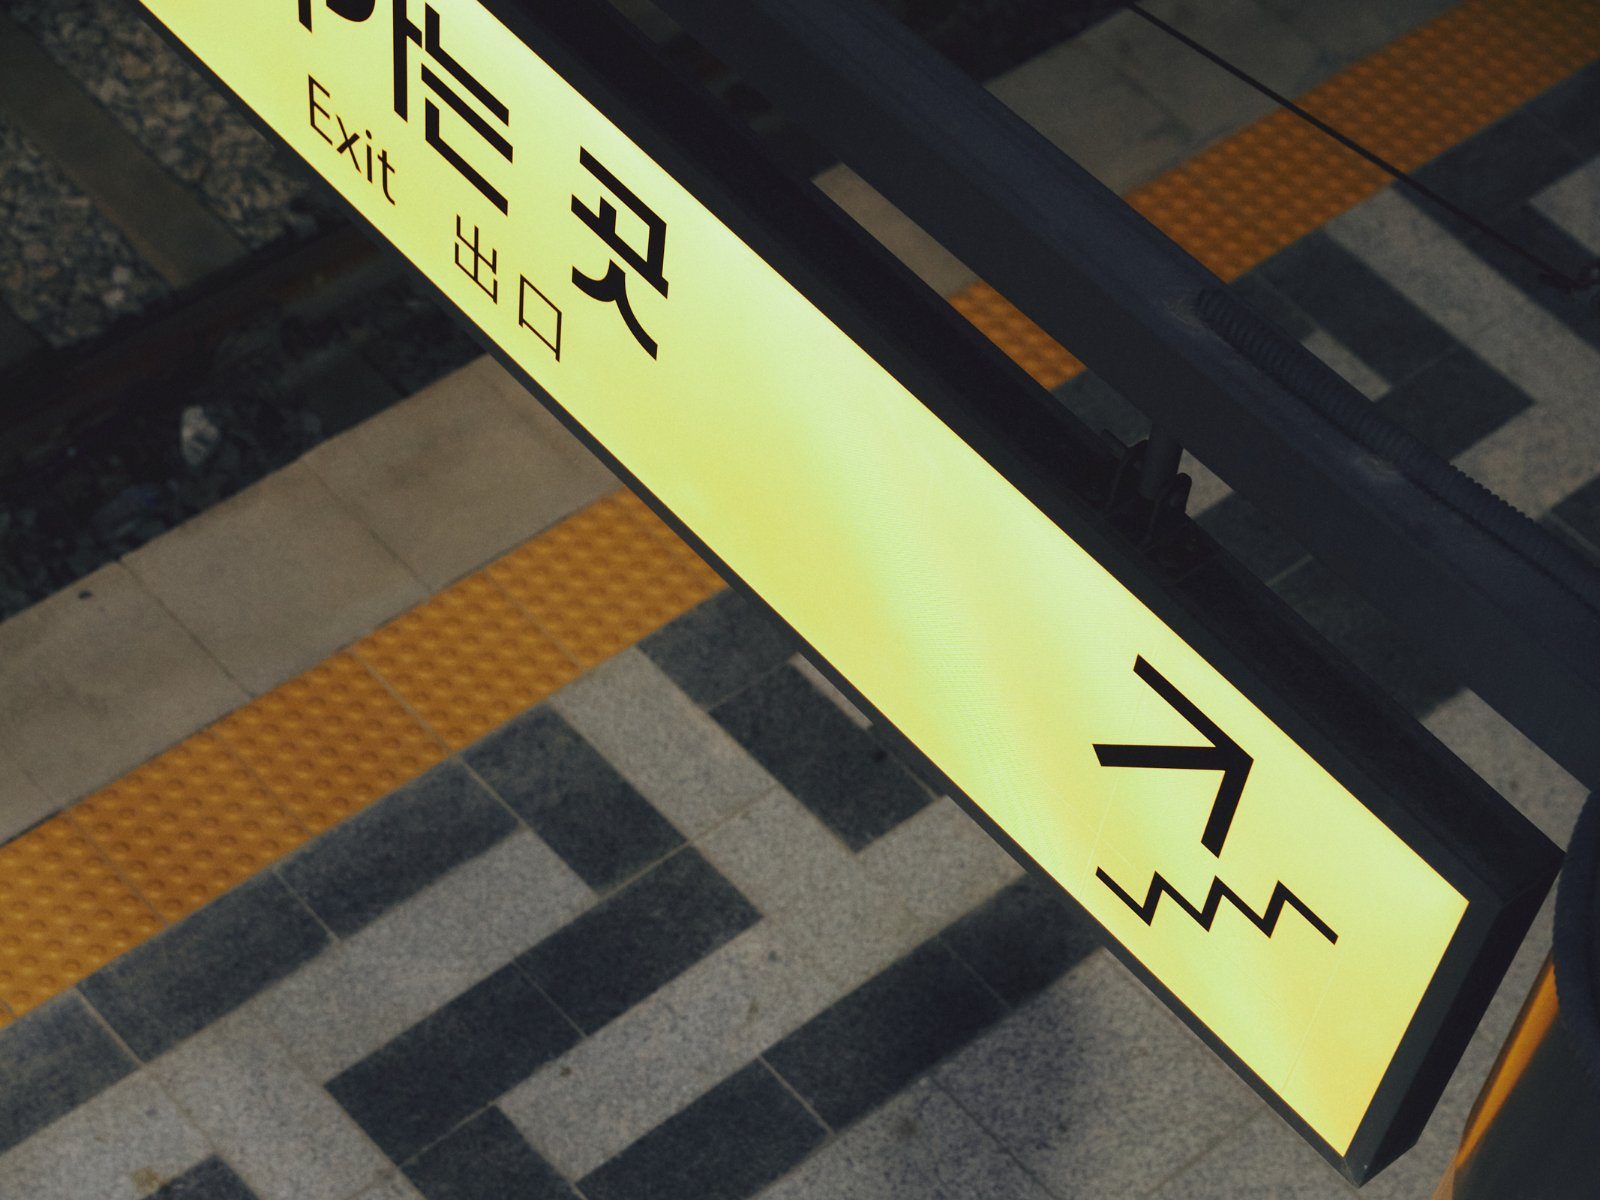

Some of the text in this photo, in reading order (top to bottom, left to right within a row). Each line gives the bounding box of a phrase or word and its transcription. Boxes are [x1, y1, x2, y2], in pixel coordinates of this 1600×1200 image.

[308, 74, 396, 206] Exit
[454, 214, 562, 363] 出口
[571, 145, 669, 361] 곳
